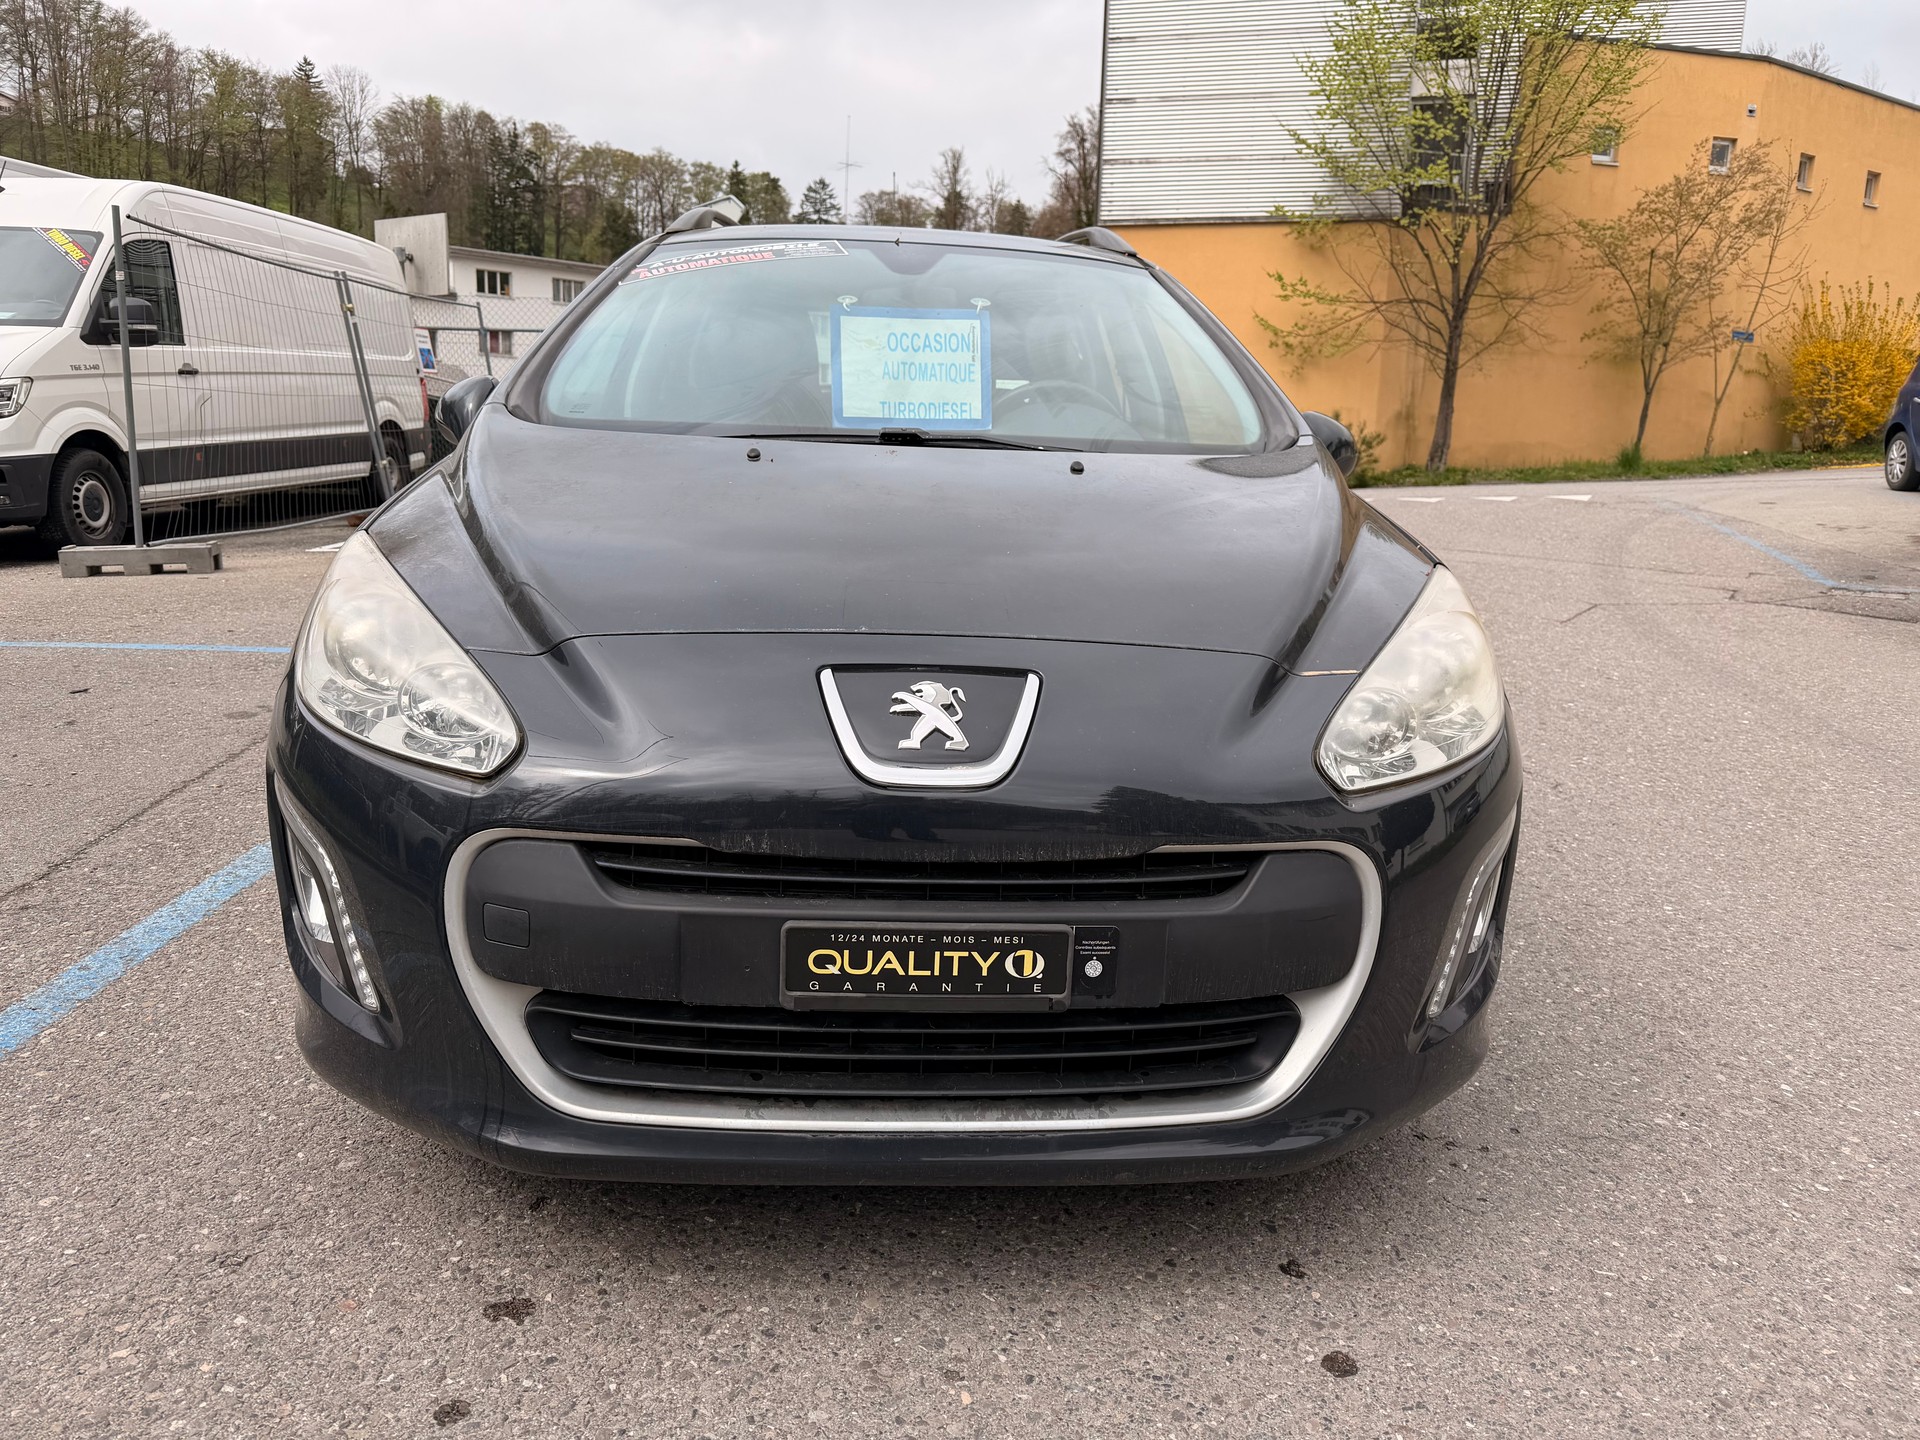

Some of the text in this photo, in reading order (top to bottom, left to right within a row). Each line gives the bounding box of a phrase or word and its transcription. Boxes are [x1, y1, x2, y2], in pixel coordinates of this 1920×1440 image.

[639, 251, 776, 279] AUTOMATIQUE
[887, 331, 971, 353] OCCASION
[881, 360, 977, 384] AUTOMATIQUE
[830, 934, 1025, 944] 12/24 MONATE MOIS MESI
[807, 948, 1001, 977] QUALITY
[809, 981, 1042, 993] GARANTIE
